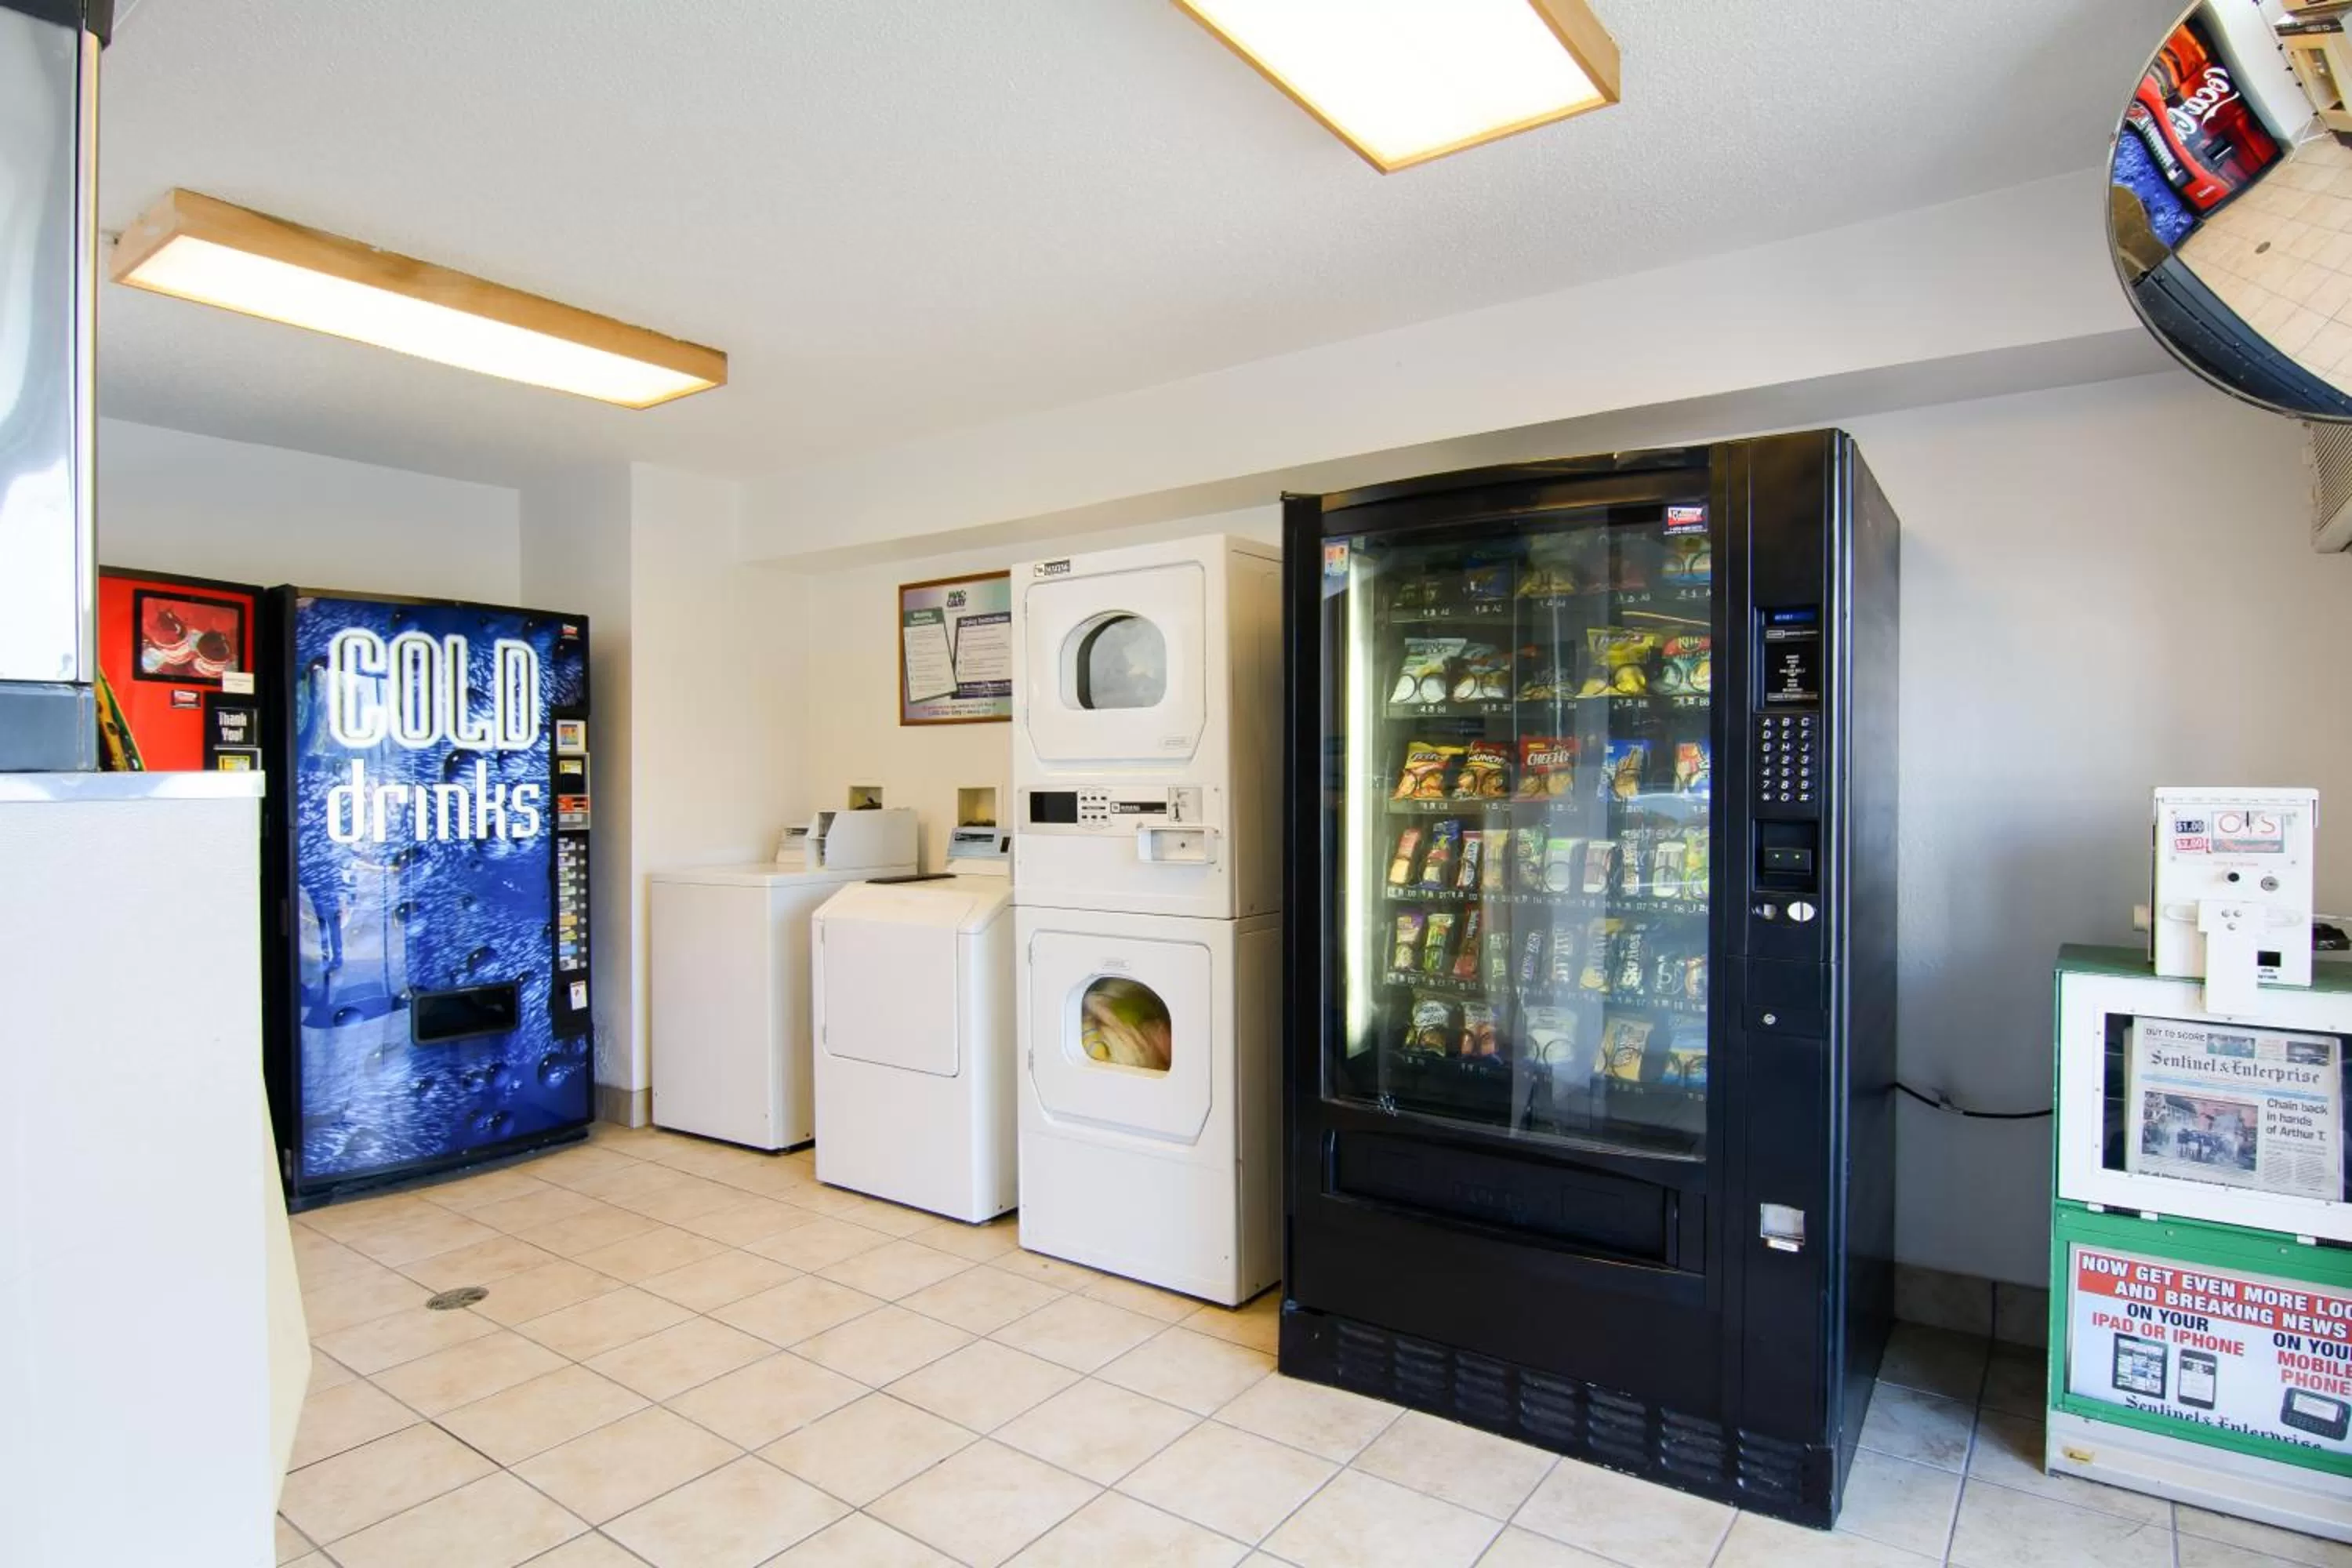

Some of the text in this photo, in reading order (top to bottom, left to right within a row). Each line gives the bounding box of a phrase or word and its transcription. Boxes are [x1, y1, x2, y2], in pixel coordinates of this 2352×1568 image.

[328, 627, 539, 750] COLD
[218, 711, 247, 727] Thank
[1763, 718, 1770, 727] A
[1801, 730, 1809, 739] F
[1781, 742, 1790, 752] H
[1801, 742, 1809, 752] J
[1762, 768, 1769, 776] 4
[1763, 780, 1770, 789] 7
[327, 758, 540, 843] drinks
[2165, 1029, 2176, 1038] TO
[2177, 1031, 2205, 1042] SCORE
[2151, 1050, 2216, 1072] Sentinel
[2220, 1062, 2230, 1073] &
[2232, 1060, 2320, 1084] Enterprise
[2267, 1098, 2328, 1115] Chain back
[2267, 1111, 2313, 1127] in hands
[2265, 1125, 2277, 1135] of
[2279, 1127, 2314, 1139] Arthur
[2082, 1255, 2129, 1277] NOW
[2136, 1266, 2174, 1286] GET
[2182, 1274, 2235, 1298] EVEN
[2244, 1286, 2309, 1312] MORE
[2114, 1280, 2347, 1339] AND BREAKING NEWS
[2127, 1303, 2209, 1332] ON YOUR
[2092, 1312, 2245, 1357] IPAD OR IPHONE
[2273, 1332, 2352, 1362] ON YOU
[2281, 1368, 2352, 1396] PHONE
[2125, 1396, 2201, 1424] Sentinel
